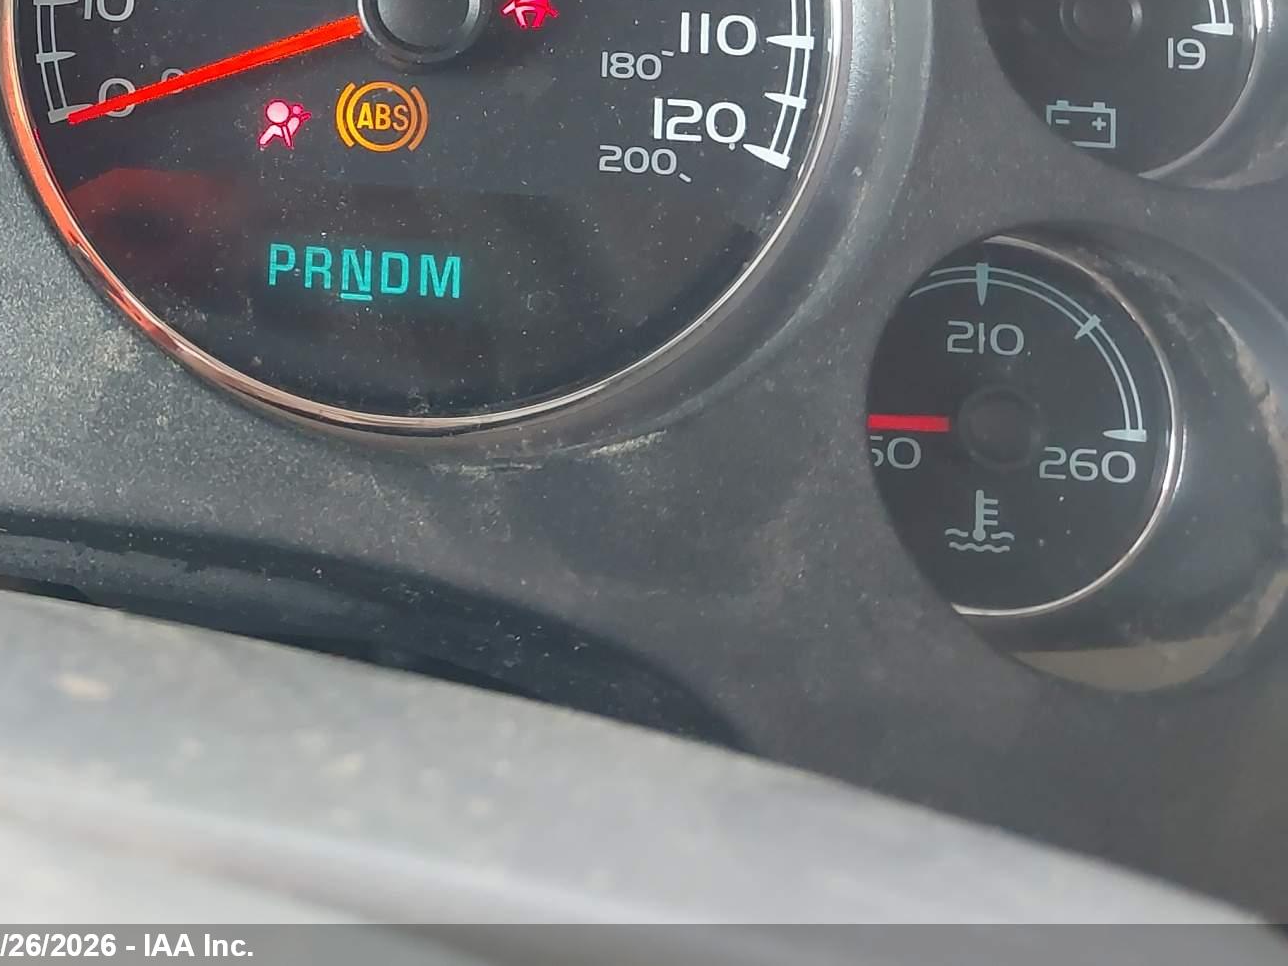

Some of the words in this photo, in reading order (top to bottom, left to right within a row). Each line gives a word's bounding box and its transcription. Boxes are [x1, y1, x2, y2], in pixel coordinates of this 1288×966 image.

[680, 12, 757, 55] 110
[601, 51, 662, 80] 180
[1167, 37, 1208, 70] 19
[357, 101, 409, 133] ABS
[653, 97, 746, 143] 120
[598, 144, 677, 175] 200
[946, 319, 1026, 356] 210
[1039, 445, 1138, 484] 260
